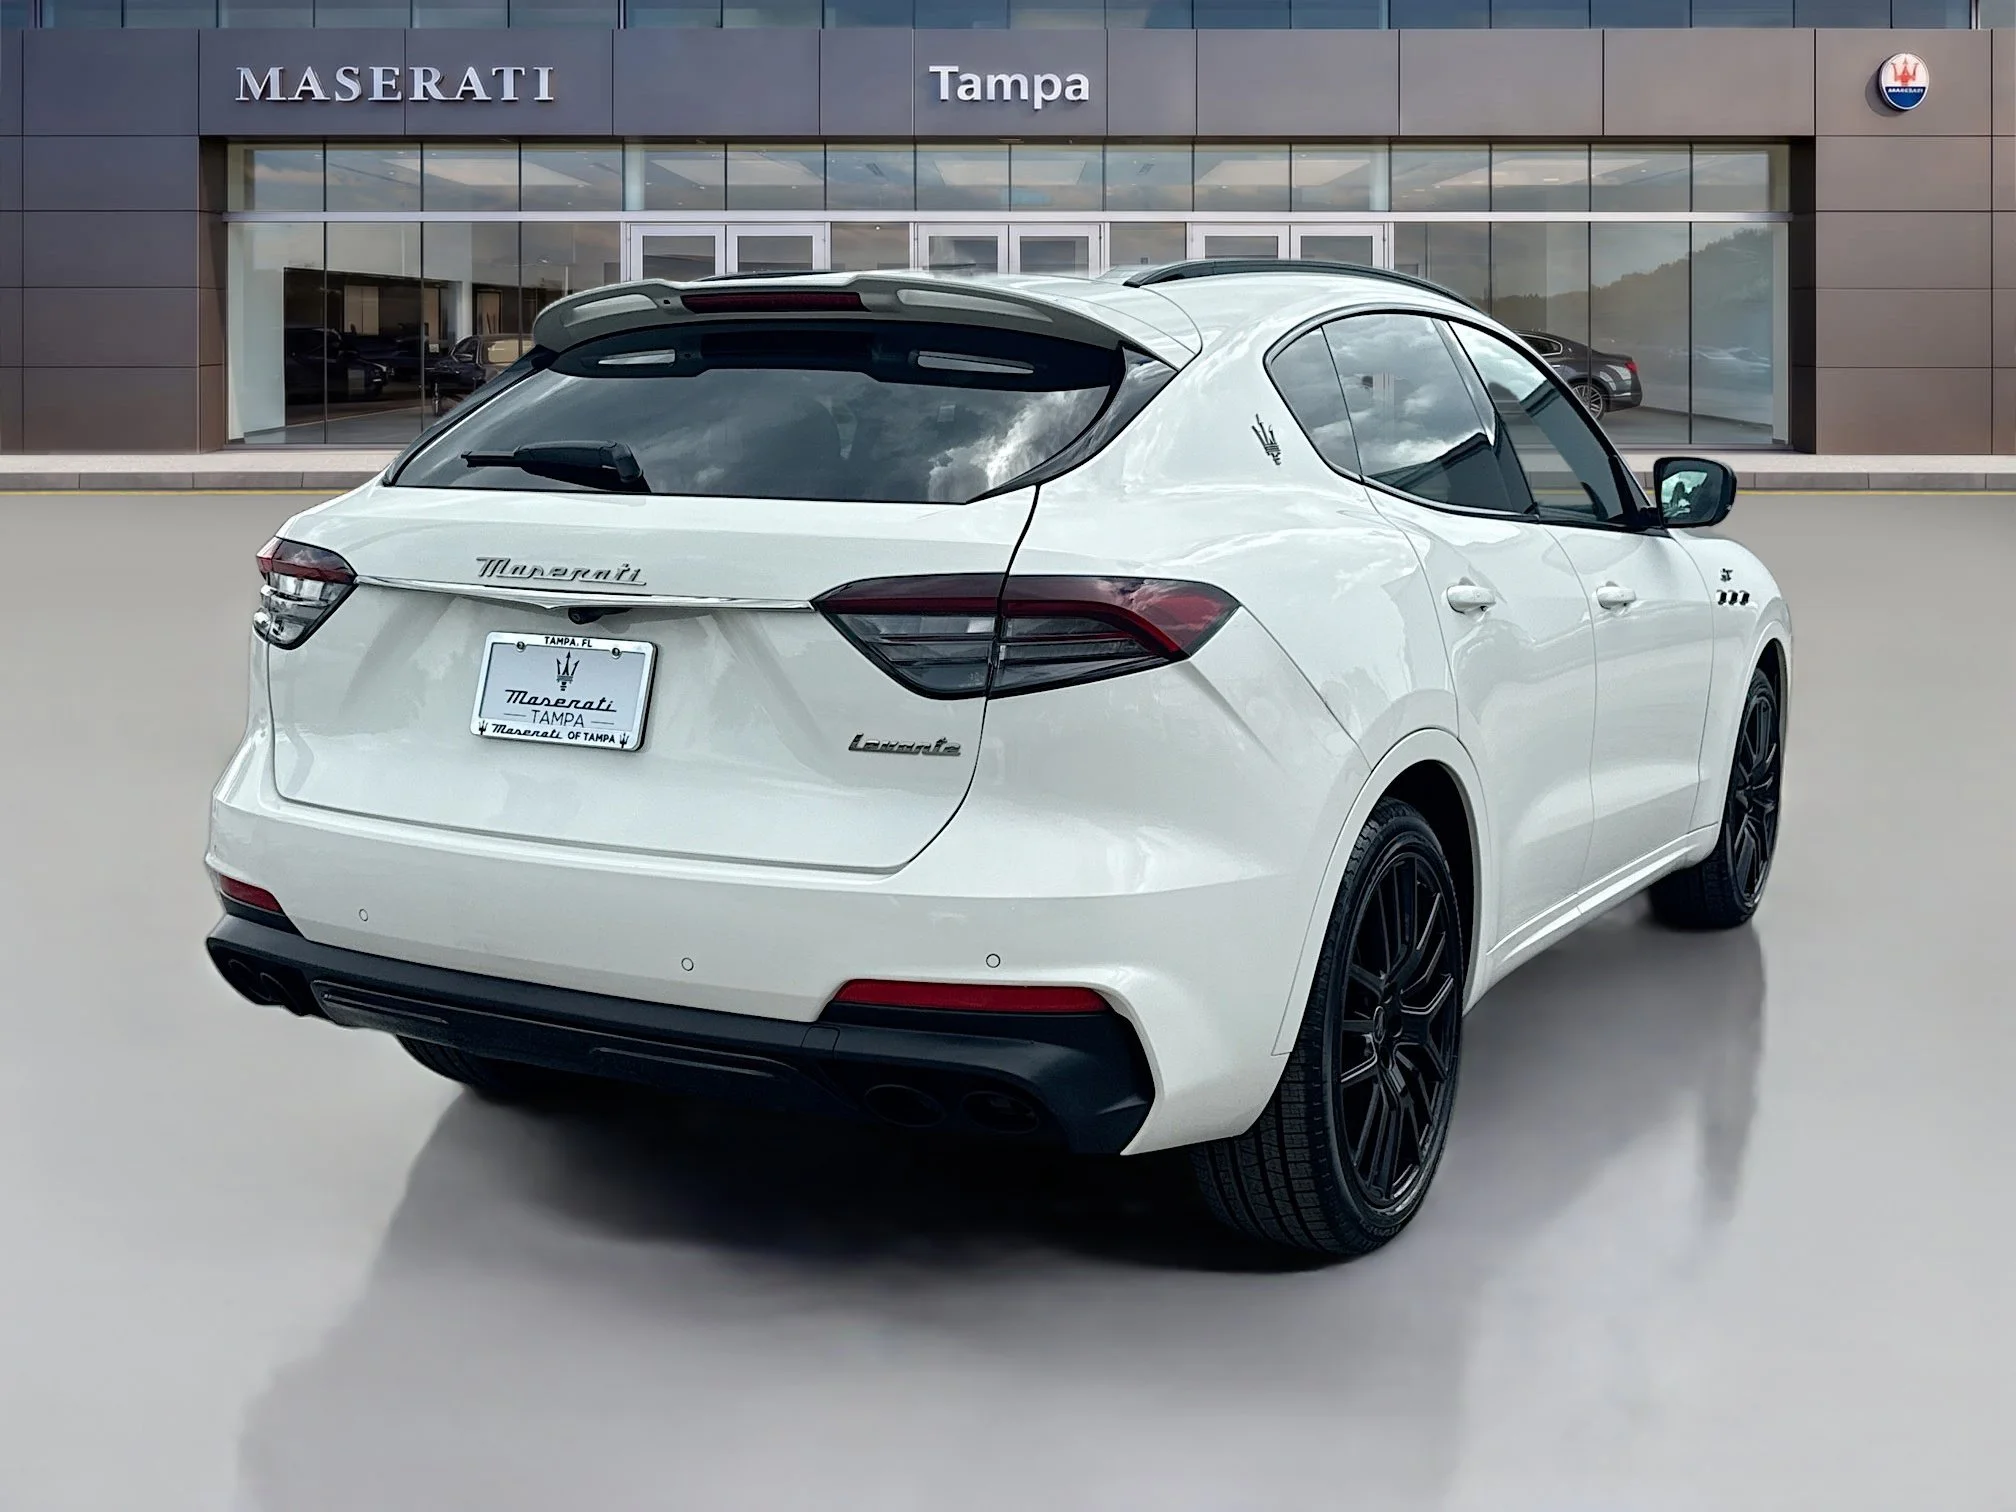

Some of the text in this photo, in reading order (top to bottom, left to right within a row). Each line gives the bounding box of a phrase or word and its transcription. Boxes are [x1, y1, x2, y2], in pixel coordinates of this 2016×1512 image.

[235, 66, 555, 101] MASERATI
[929, 65, 1090, 110] Tampa
[476, 556, 647, 586] Maserati
[581, 638, 593, 648] FL
[505, 689, 617, 713] Maserati
[531, 709, 585, 728] TAMPA
[491, 723, 616, 744] Maserati OF TAMPA
